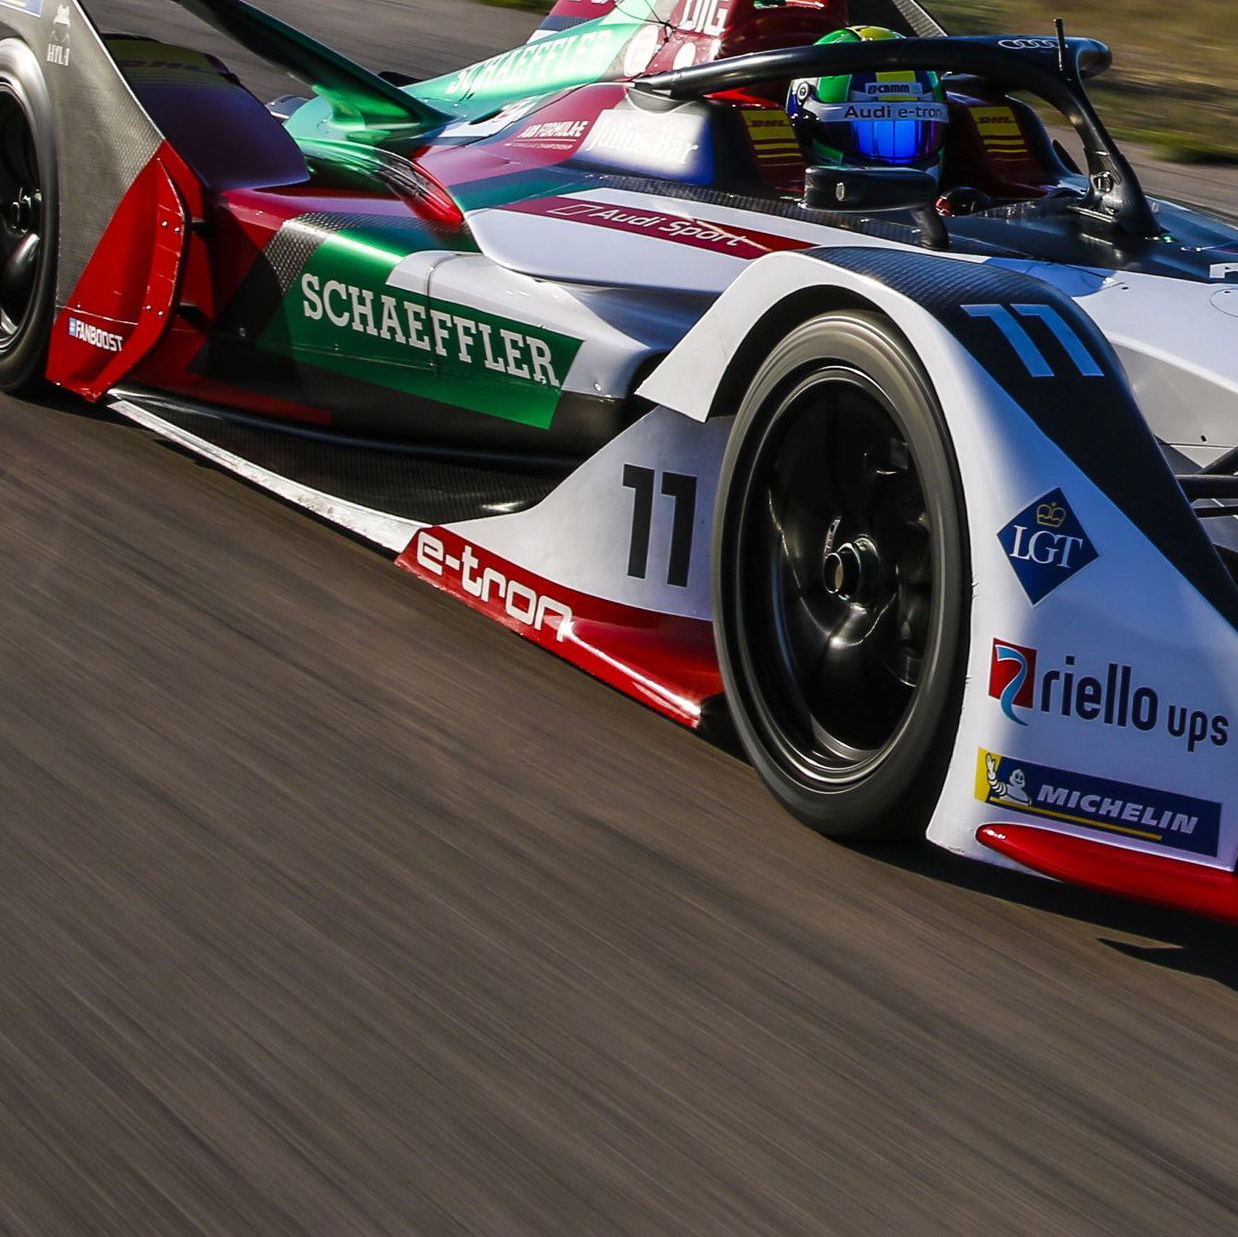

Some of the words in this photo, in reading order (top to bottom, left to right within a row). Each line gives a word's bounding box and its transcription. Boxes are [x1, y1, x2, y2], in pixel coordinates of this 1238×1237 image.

[446, 29, 612, 94] SCHAEFFLER
[586, 116, 648, 153] Julius
[844, 105, 891, 118] Audi
[897, 106, 943, 119] e-tron
[590, 208, 659, 228] Audi
[659, 221, 747, 246] Sport
[76, 319, 124, 352] FANBOOST
[301, 273, 561, 387] SCHAEFFLER
[960, 303, 1105, 377] 11
[622, 463, 698, 588] 11
[1008, 524, 1085, 569] LGT
[417, 531, 574, 643] e-tron
[1040, 655, 1159, 732] riello
[1167, 705, 1230, 753] ups
[1036, 783, 1199, 835] MICHELIN
